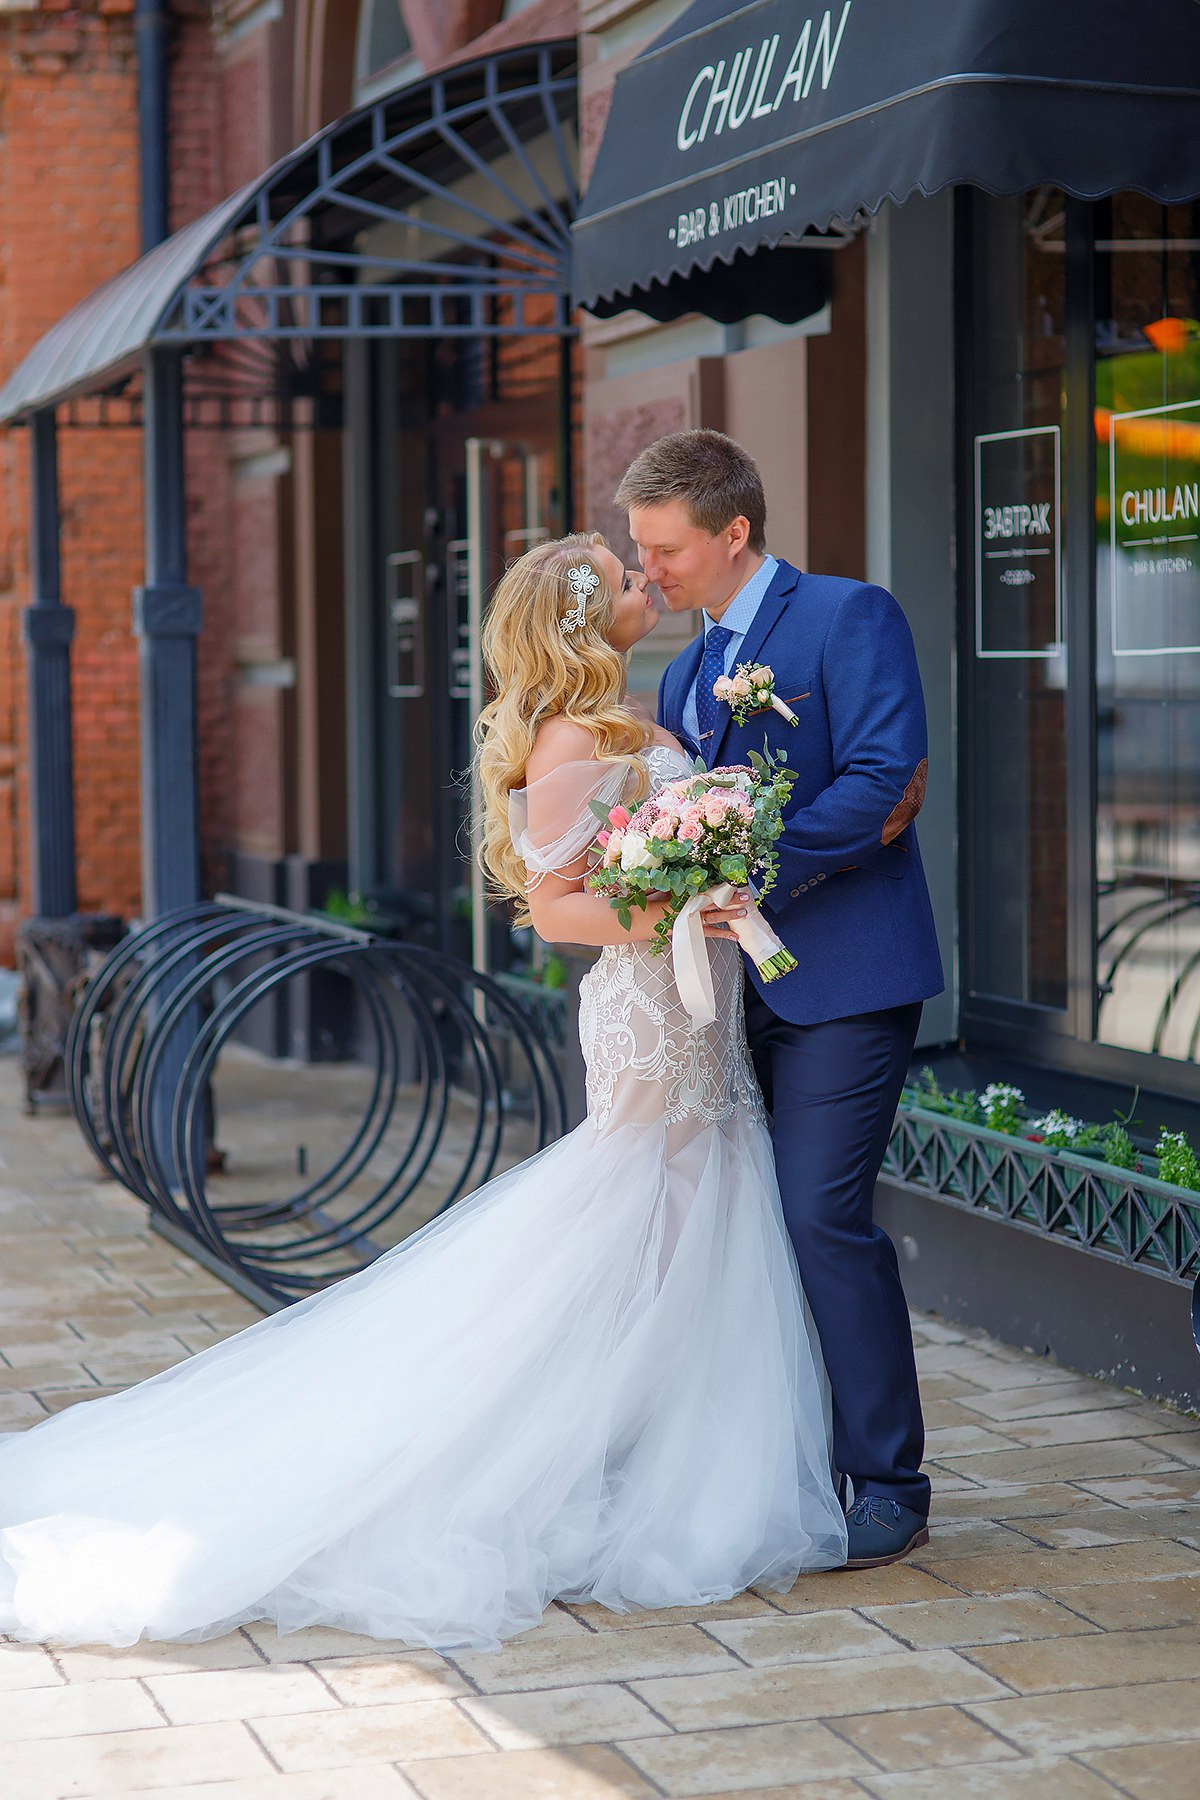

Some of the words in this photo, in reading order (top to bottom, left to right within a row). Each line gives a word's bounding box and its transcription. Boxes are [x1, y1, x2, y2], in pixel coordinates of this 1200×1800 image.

[677, 0, 851, 151] CHULAN
[677, 207, 706, 248] BAR
[708, 202, 720, 237] &
[723, 176, 786, 231] KITCHEN
[984, 502, 1051, 539] ЗАВТРАК
[1121, 482, 1199, 526] CHULAN
